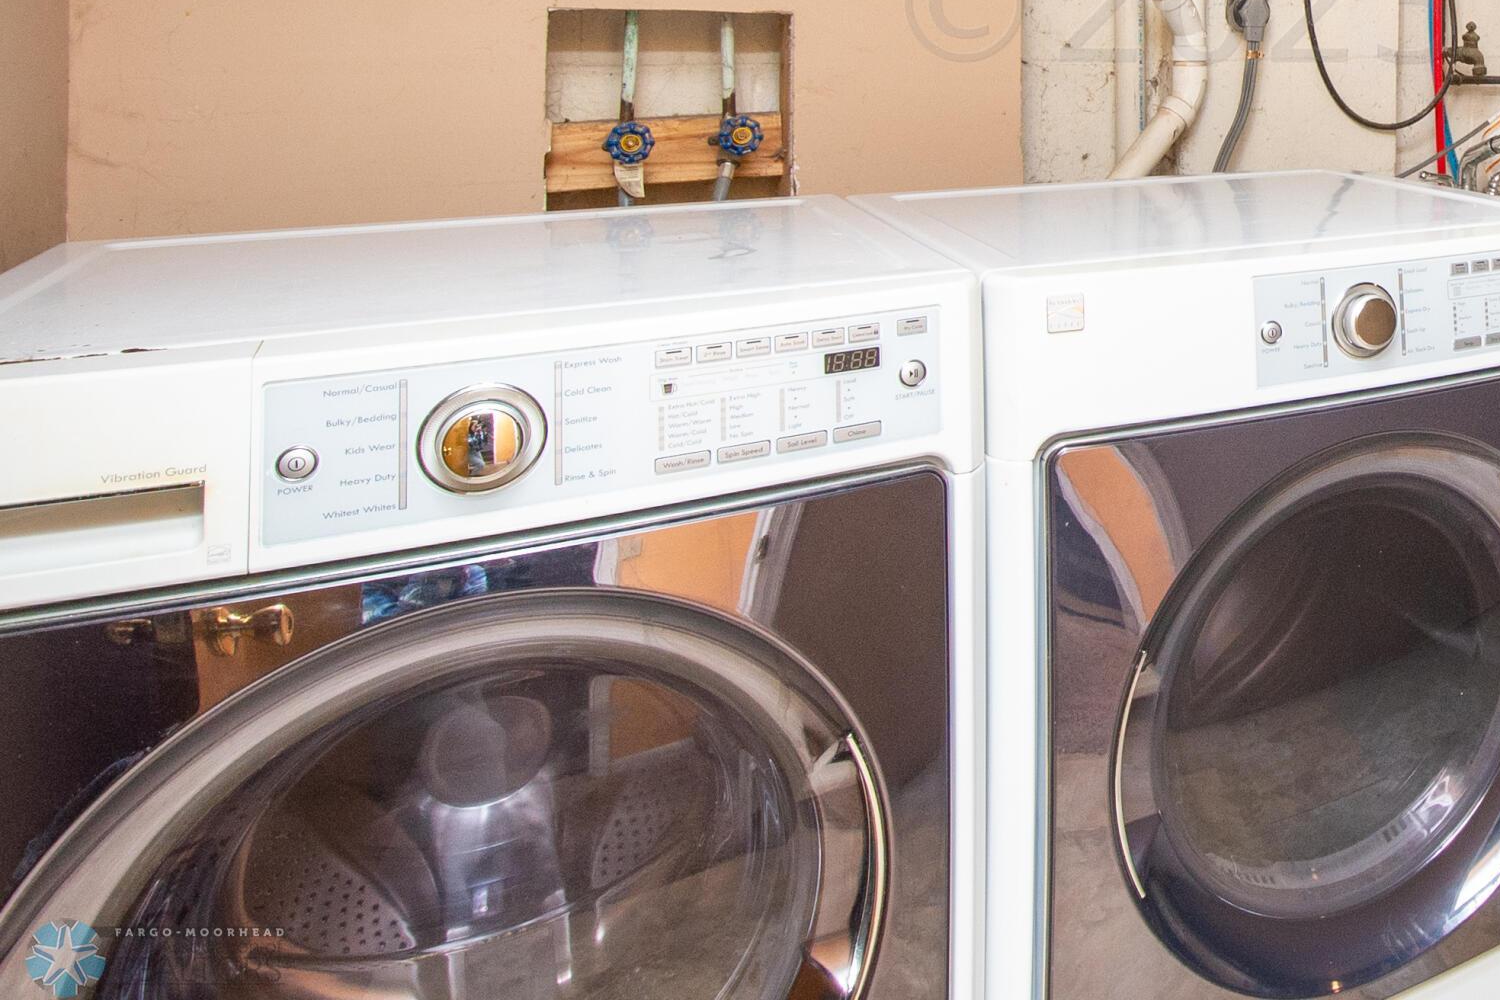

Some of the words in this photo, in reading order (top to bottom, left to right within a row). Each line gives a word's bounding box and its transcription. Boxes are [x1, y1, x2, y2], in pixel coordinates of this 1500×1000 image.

[564, 359, 596, 370] Express
[598, 355, 622, 365] Wash
[322, 382, 398, 399] Normal/Casual
[564, 388, 585, 398] Cold
[586, 385, 612, 395] Clean
[325, 412, 398, 428] Bulky/Bedding
[564, 415, 598, 426] Sanitize
[344, 444, 365, 456] Kids
[367, 442, 396, 453] Wear
[564, 443, 603, 454] Delicates
[787, 440, 799, 448] Soil
[724, 449, 740, 460] Spin
[741, 445, 764, 457] Speed
[663, 457, 705, 469] Wash/Rinse
[100, 469, 161, 485] Vibration
[164, 463, 208, 478] Guard
[339, 477, 372, 488] Heavy
[374, 473, 397, 483] Duty
[564, 473, 586, 483] Rinse
[598, 468, 617, 478] Spin
[276, 484, 314, 496] POWER
[322, 508, 360, 520] Whitest
[363, 502, 397, 514] Whites
